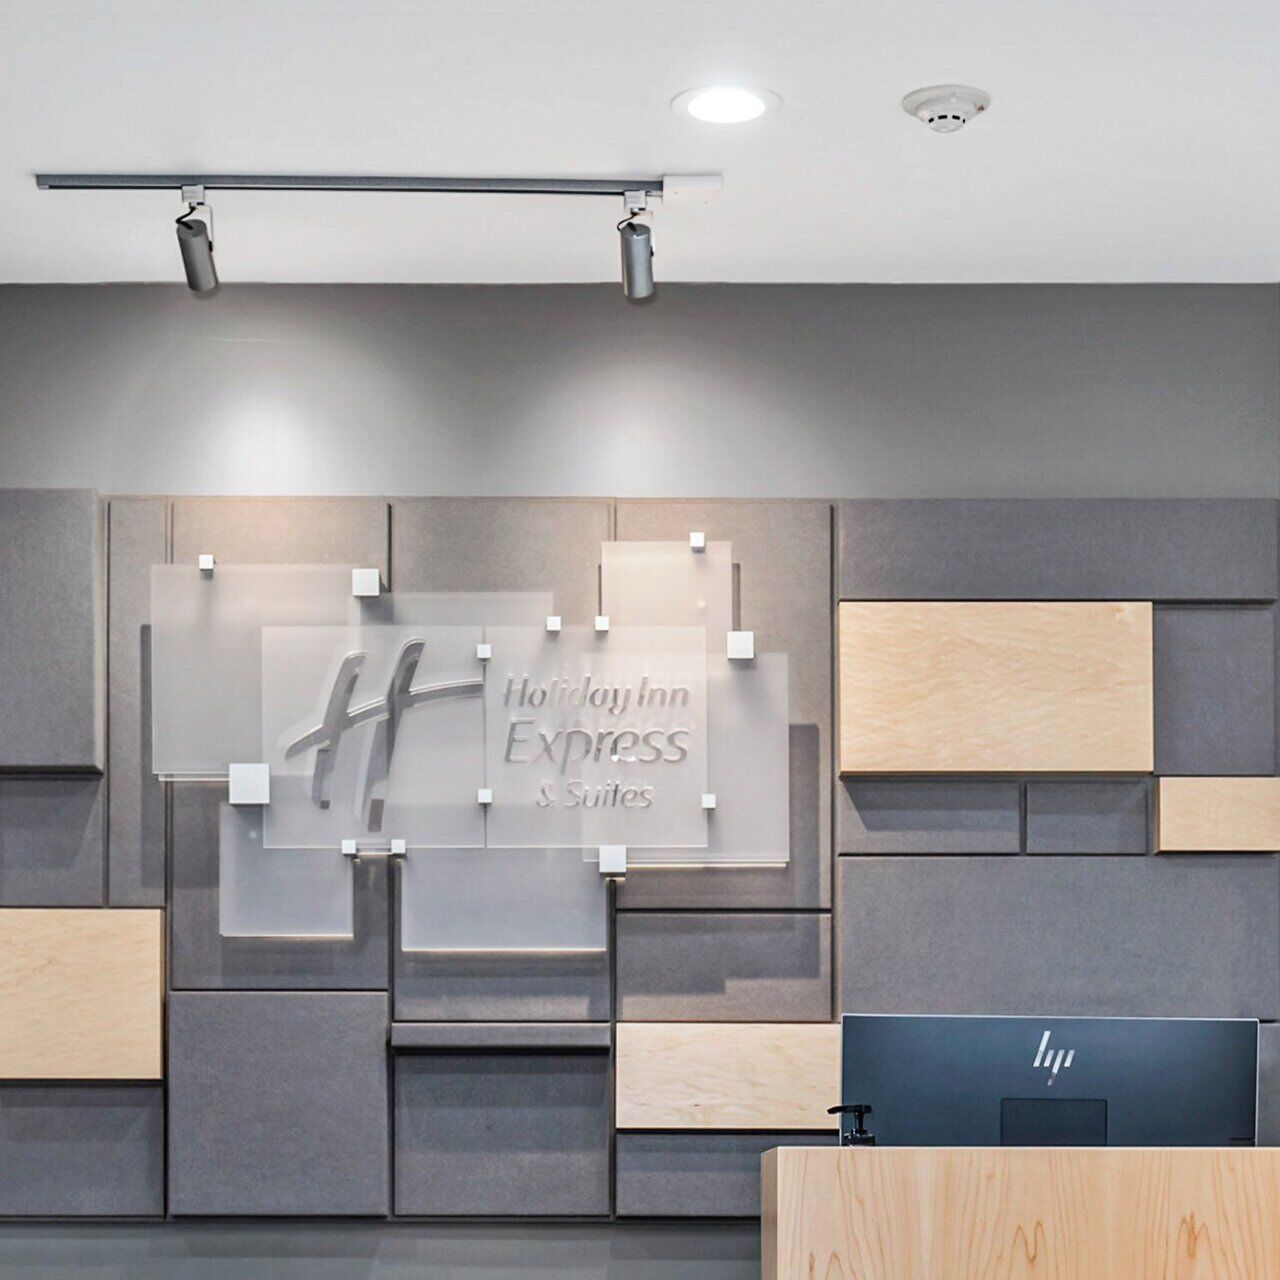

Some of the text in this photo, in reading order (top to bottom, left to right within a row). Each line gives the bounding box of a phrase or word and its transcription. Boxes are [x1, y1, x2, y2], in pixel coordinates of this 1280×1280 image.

[504, 673, 690, 716] Holiday Inn
[504, 717, 691, 776] Express
[536, 780, 655, 808] & Suites
[1033, 1030, 1076, 1087] hp
